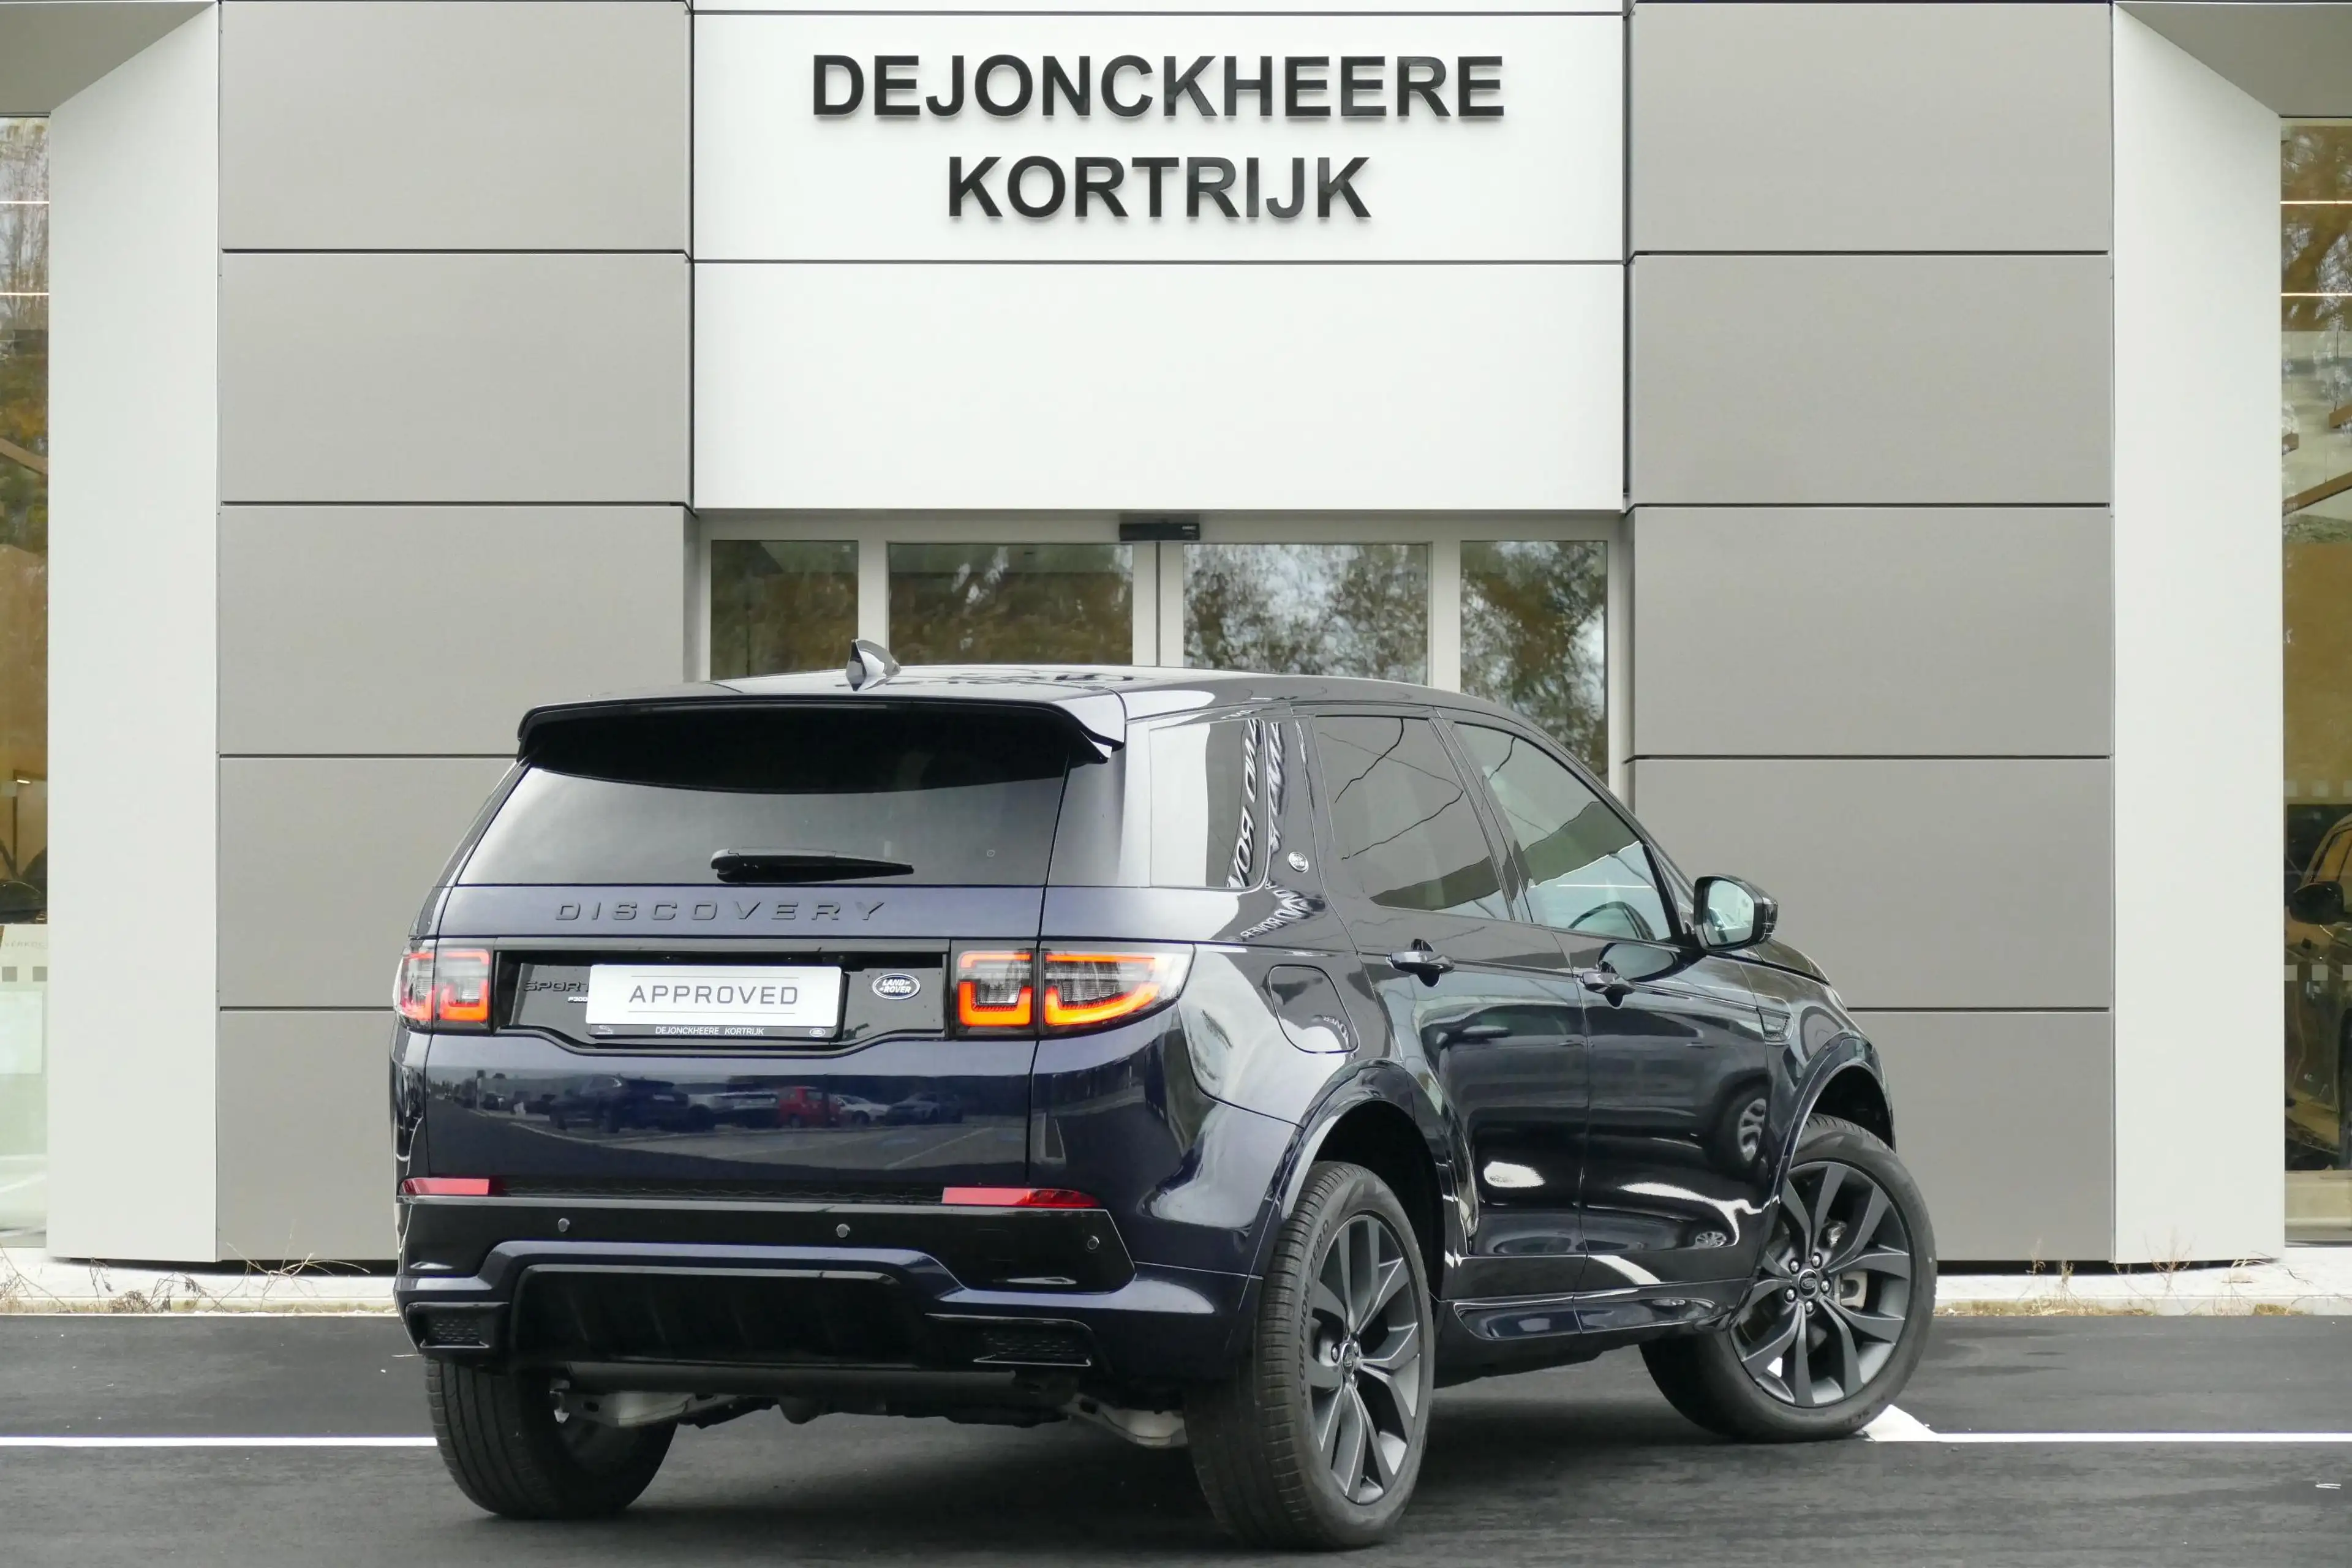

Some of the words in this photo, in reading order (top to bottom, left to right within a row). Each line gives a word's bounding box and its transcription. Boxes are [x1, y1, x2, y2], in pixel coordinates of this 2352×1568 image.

[813, 55, 1504, 117] DEJONCKHEERE
[949, 156, 1371, 218] KORTRIJK
[556, 901, 885, 921] DISCOVERY
[630, 986, 797, 1005] APPROVED
[655, 1025, 720, 1035] DEJONCKHEERE
[724, 1026, 765, 1036] KORTRIJK
[1308, 1219, 1330, 1278] ZERO
